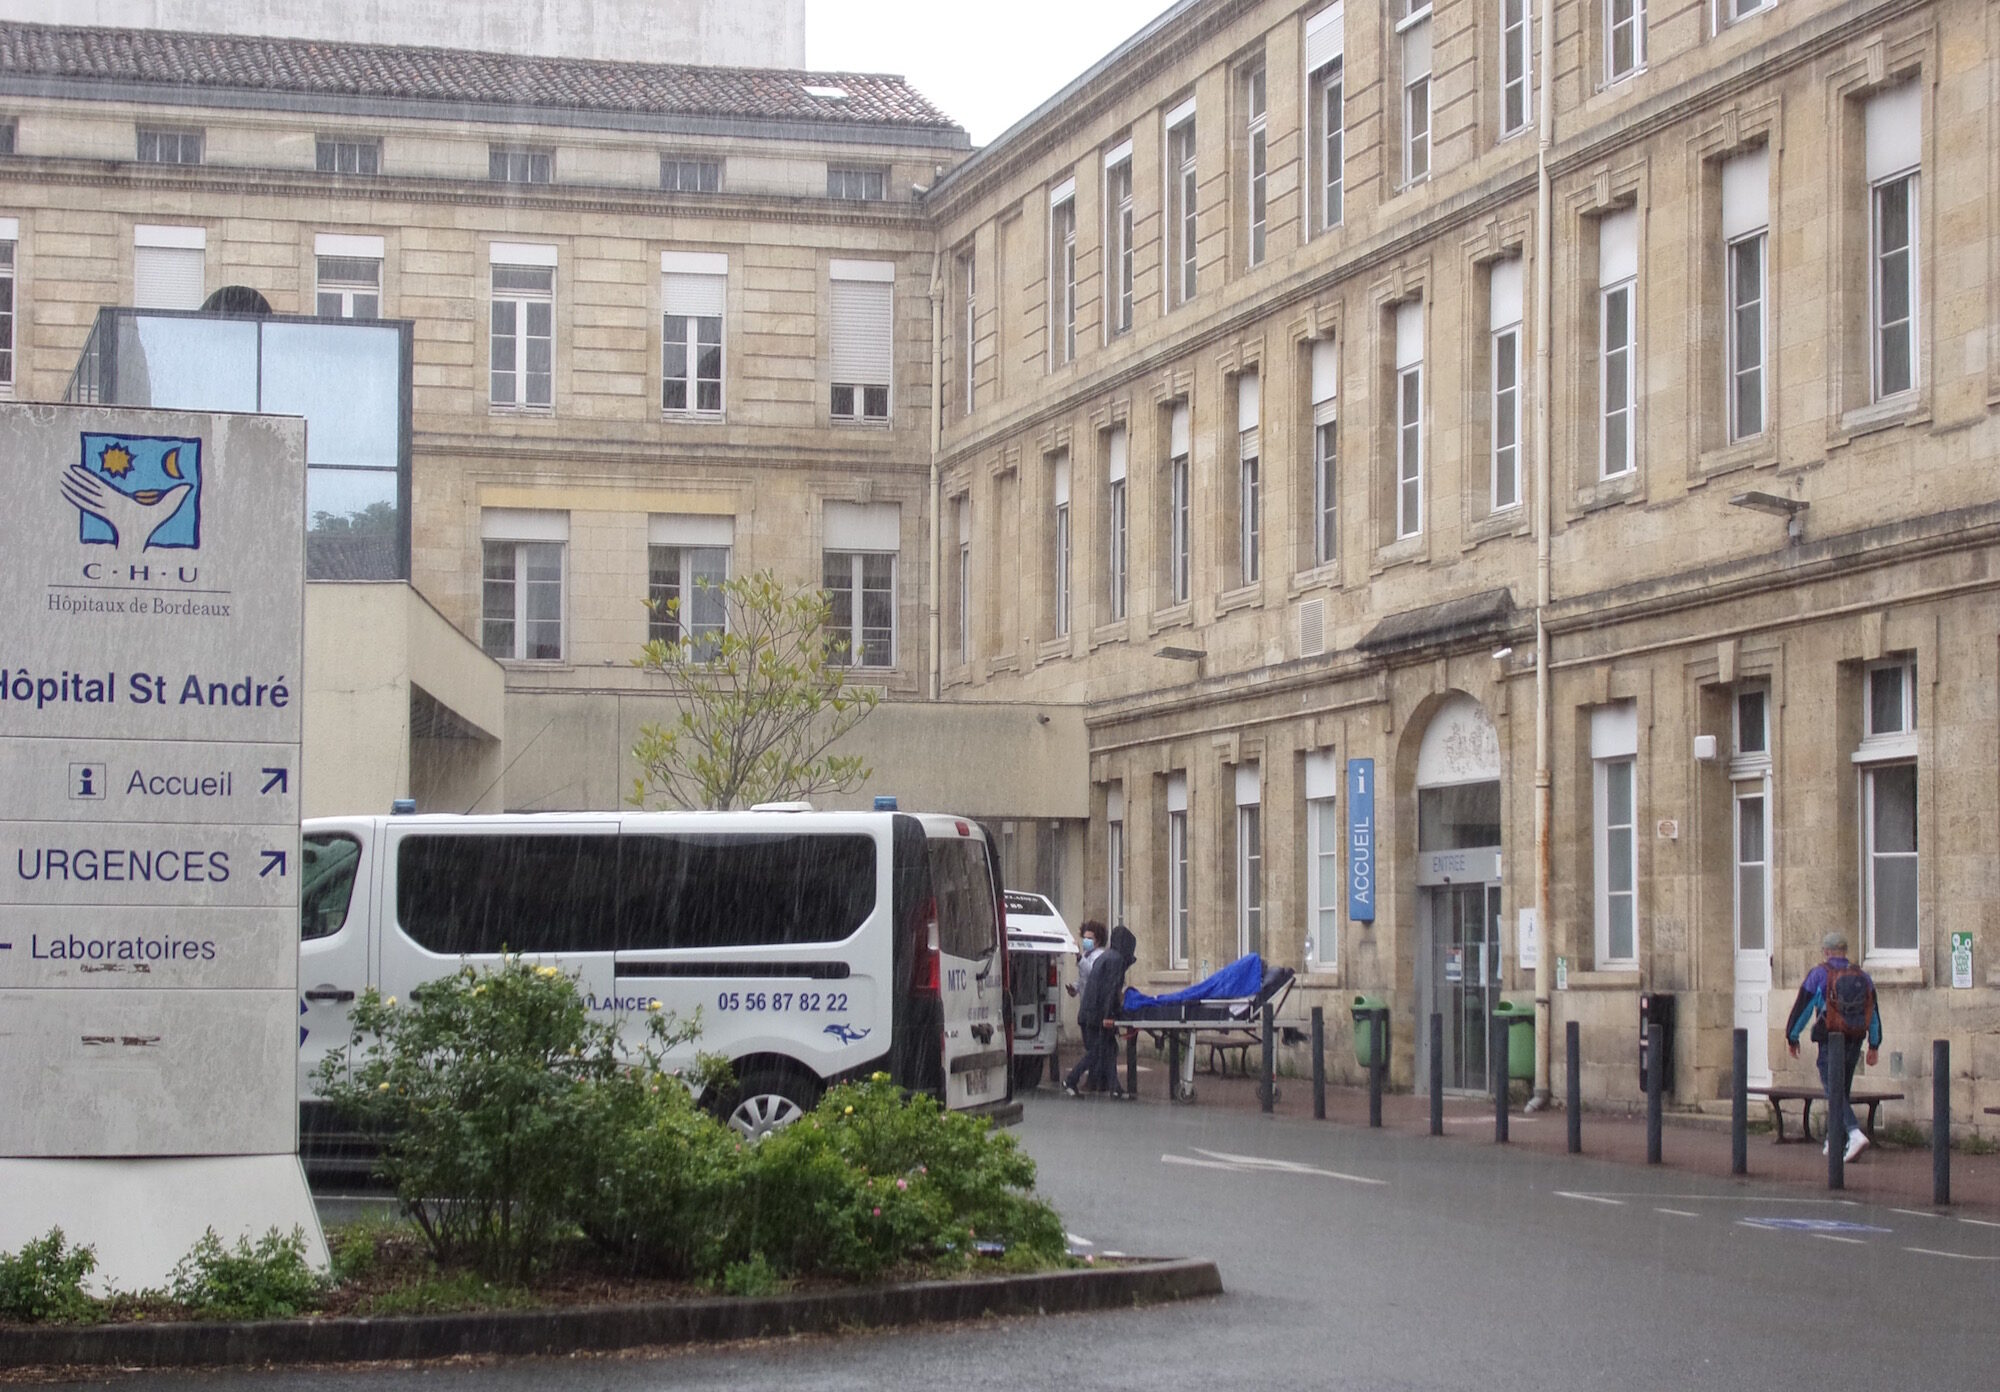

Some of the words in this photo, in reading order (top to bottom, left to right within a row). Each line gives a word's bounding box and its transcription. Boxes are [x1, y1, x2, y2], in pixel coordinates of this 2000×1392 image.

[48, 593, 125, 615] Hôpitaux
[129, 596, 148, 614] de
[152, 597, 231, 617] Bordeaux
[129, 672, 167, 705] St
[179, 674, 290, 708] André
[126, 769, 232, 797] Accueil
[17, 848, 230, 883] URGENCES
[1354, 816, 1370, 904] ACCUEIL
[31, 933, 217, 960] Laboratoires
[948, 968, 967, 992] MTC
[718, 992, 740, 1011] 05
[745, 992, 767, 1011] 56
[772, 992, 794, 1012] 87
[799, 992, 821, 1012] 82
[826, 993, 848, 1012] 22
